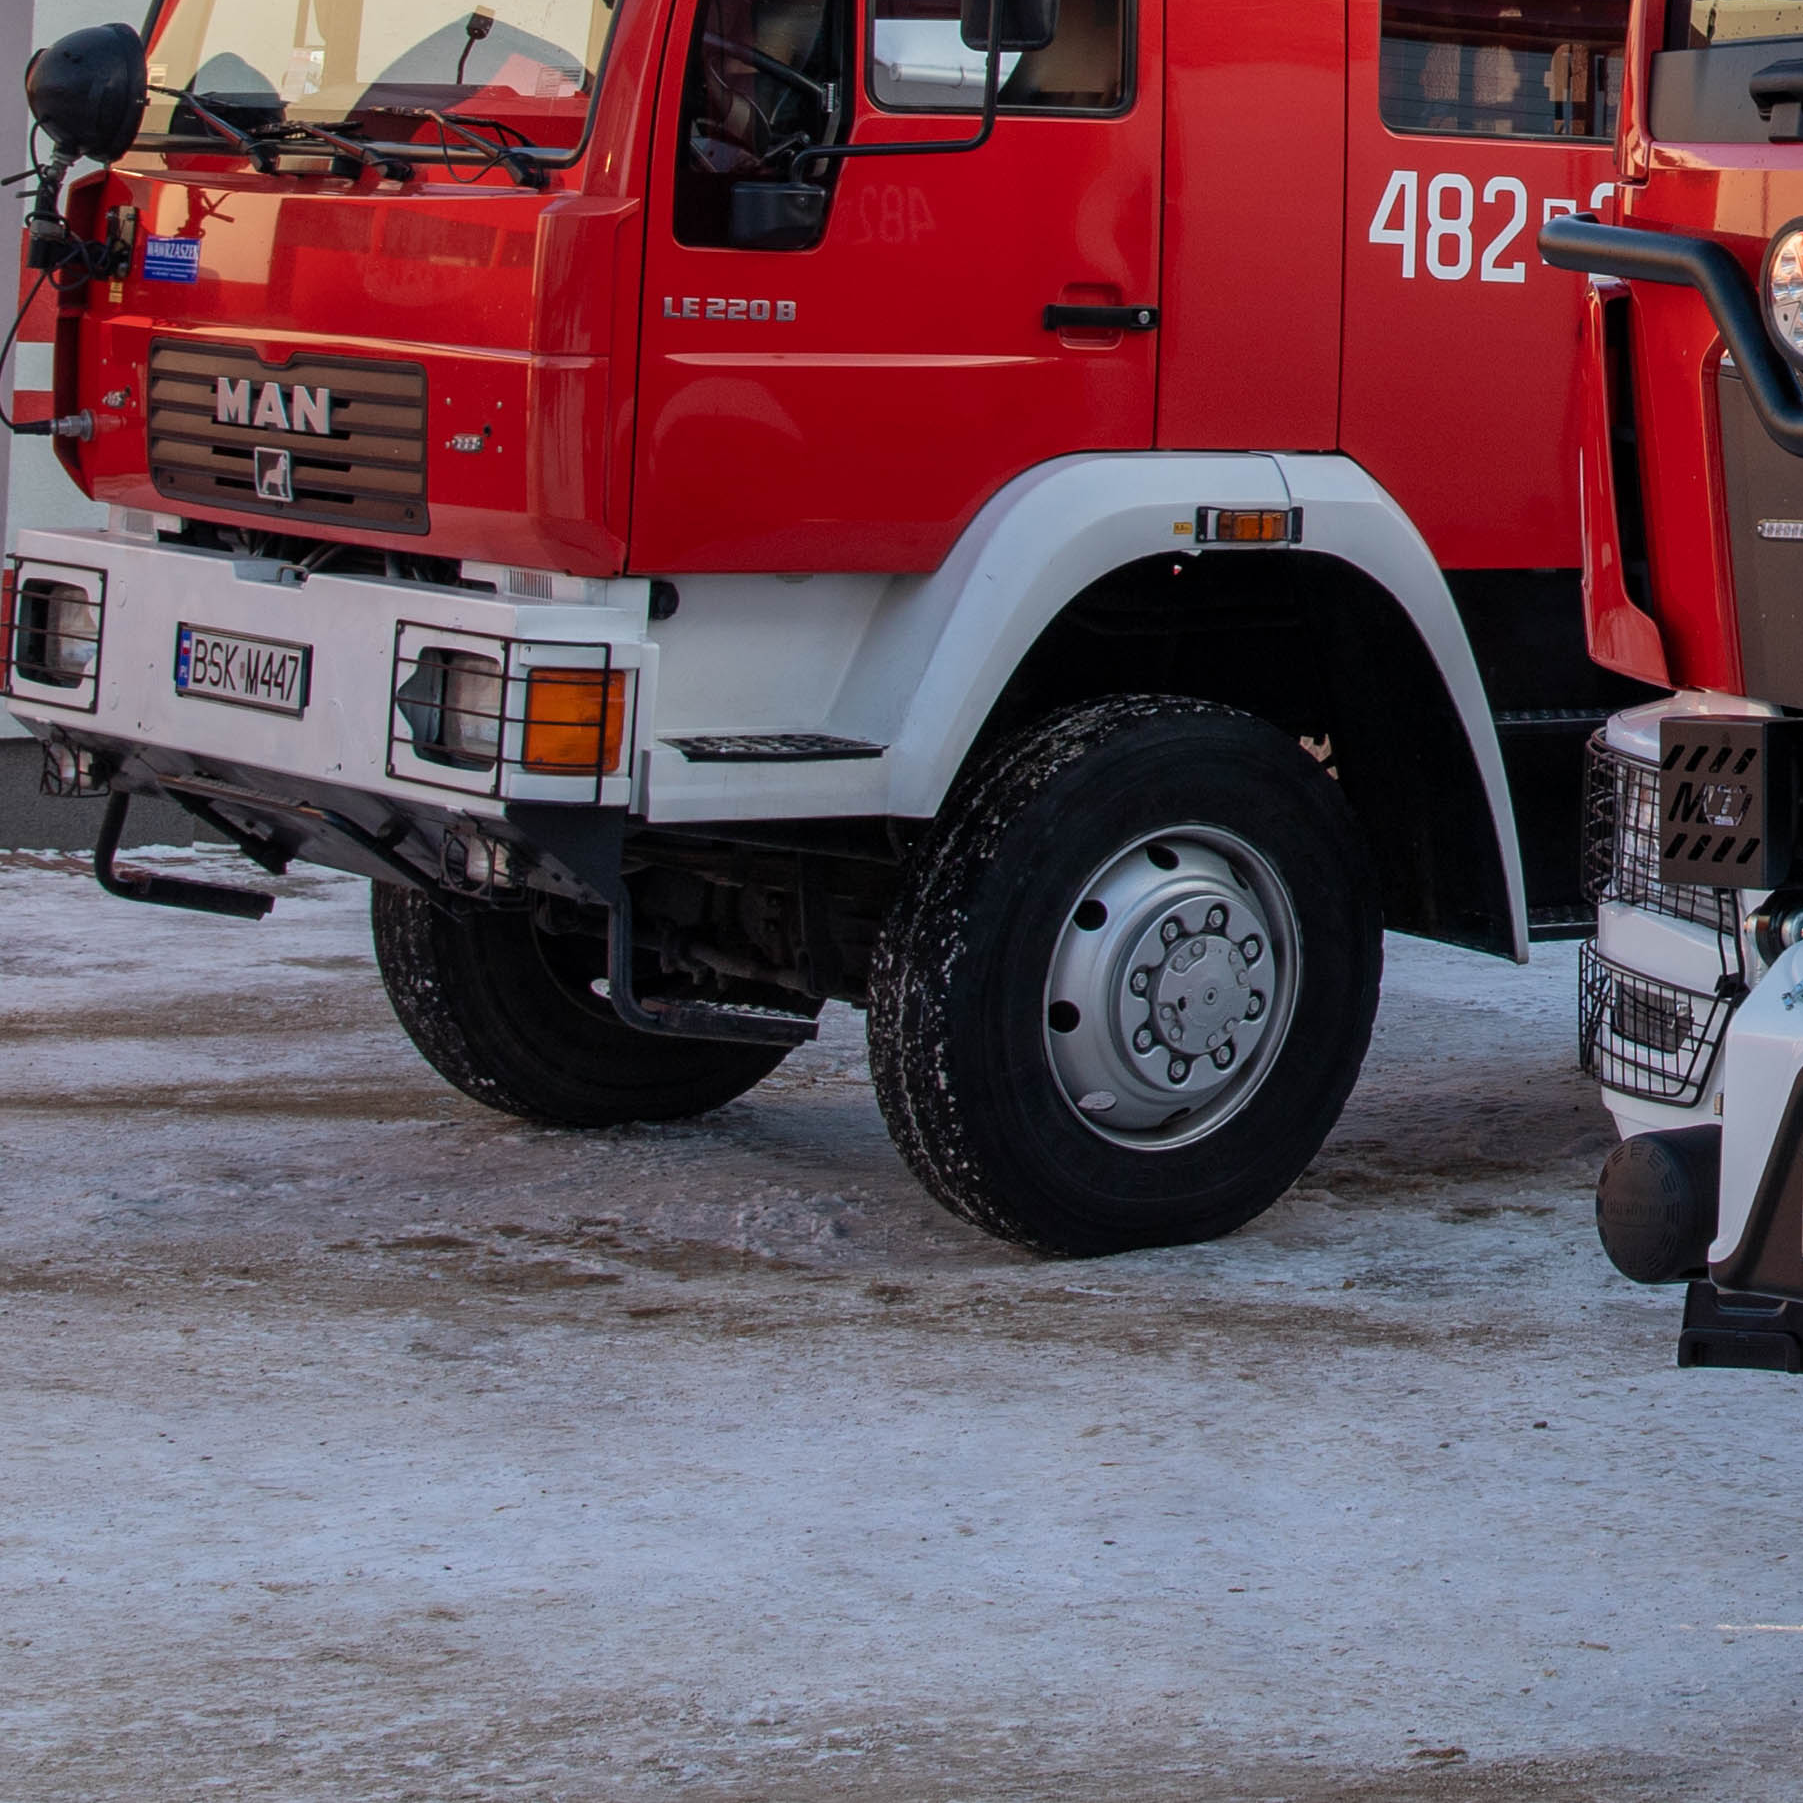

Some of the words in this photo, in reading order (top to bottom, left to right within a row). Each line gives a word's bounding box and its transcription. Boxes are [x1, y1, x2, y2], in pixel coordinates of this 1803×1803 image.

[1368, 170, 1528, 283] 482
[663, 296, 700, 319] LE
[705, 298, 771, 321] 220
[775, 300, 797, 322] B
[217, 377, 330, 434] MAN
[192, 639, 239, 691] BSK
[245, 648, 300, 702] M447
